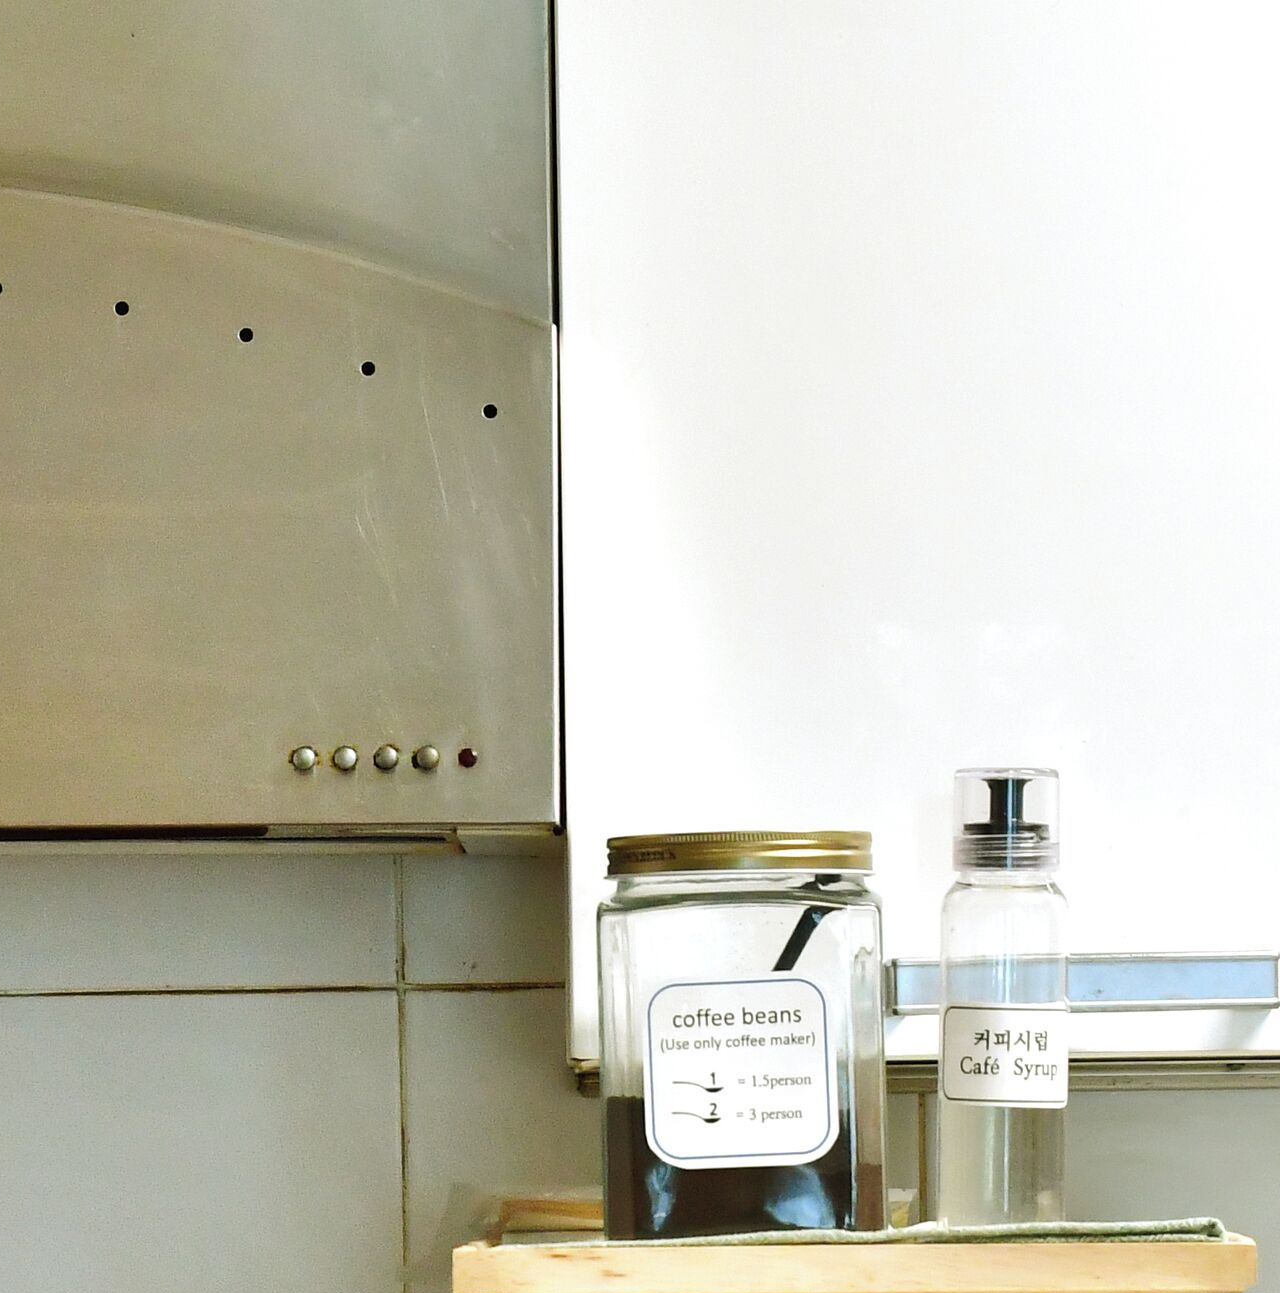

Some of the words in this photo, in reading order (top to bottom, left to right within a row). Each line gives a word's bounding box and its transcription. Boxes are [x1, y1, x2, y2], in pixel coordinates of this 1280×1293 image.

[672, 1008, 735, 1028] coffee
[742, 1007, 802, 1025] beans
[660, 1038, 690, 1053] (Use
[693, 1036, 721, 1051] only
[725, 1035, 766, 1049] coffee
[770, 1032, 816, 1047] maker)
[973, 1029, 1048, 1052] 커피시럽
[709, 1072, 717, 1085] 1
[960, 1055, 1000, 1075] Café
[1013, 1057, 1058, 1081] Syrup
[709, 1102, 718, 1116] 2
[748, 1109, 757, 1120] 3
[761, 1109, 803, 1124] person
